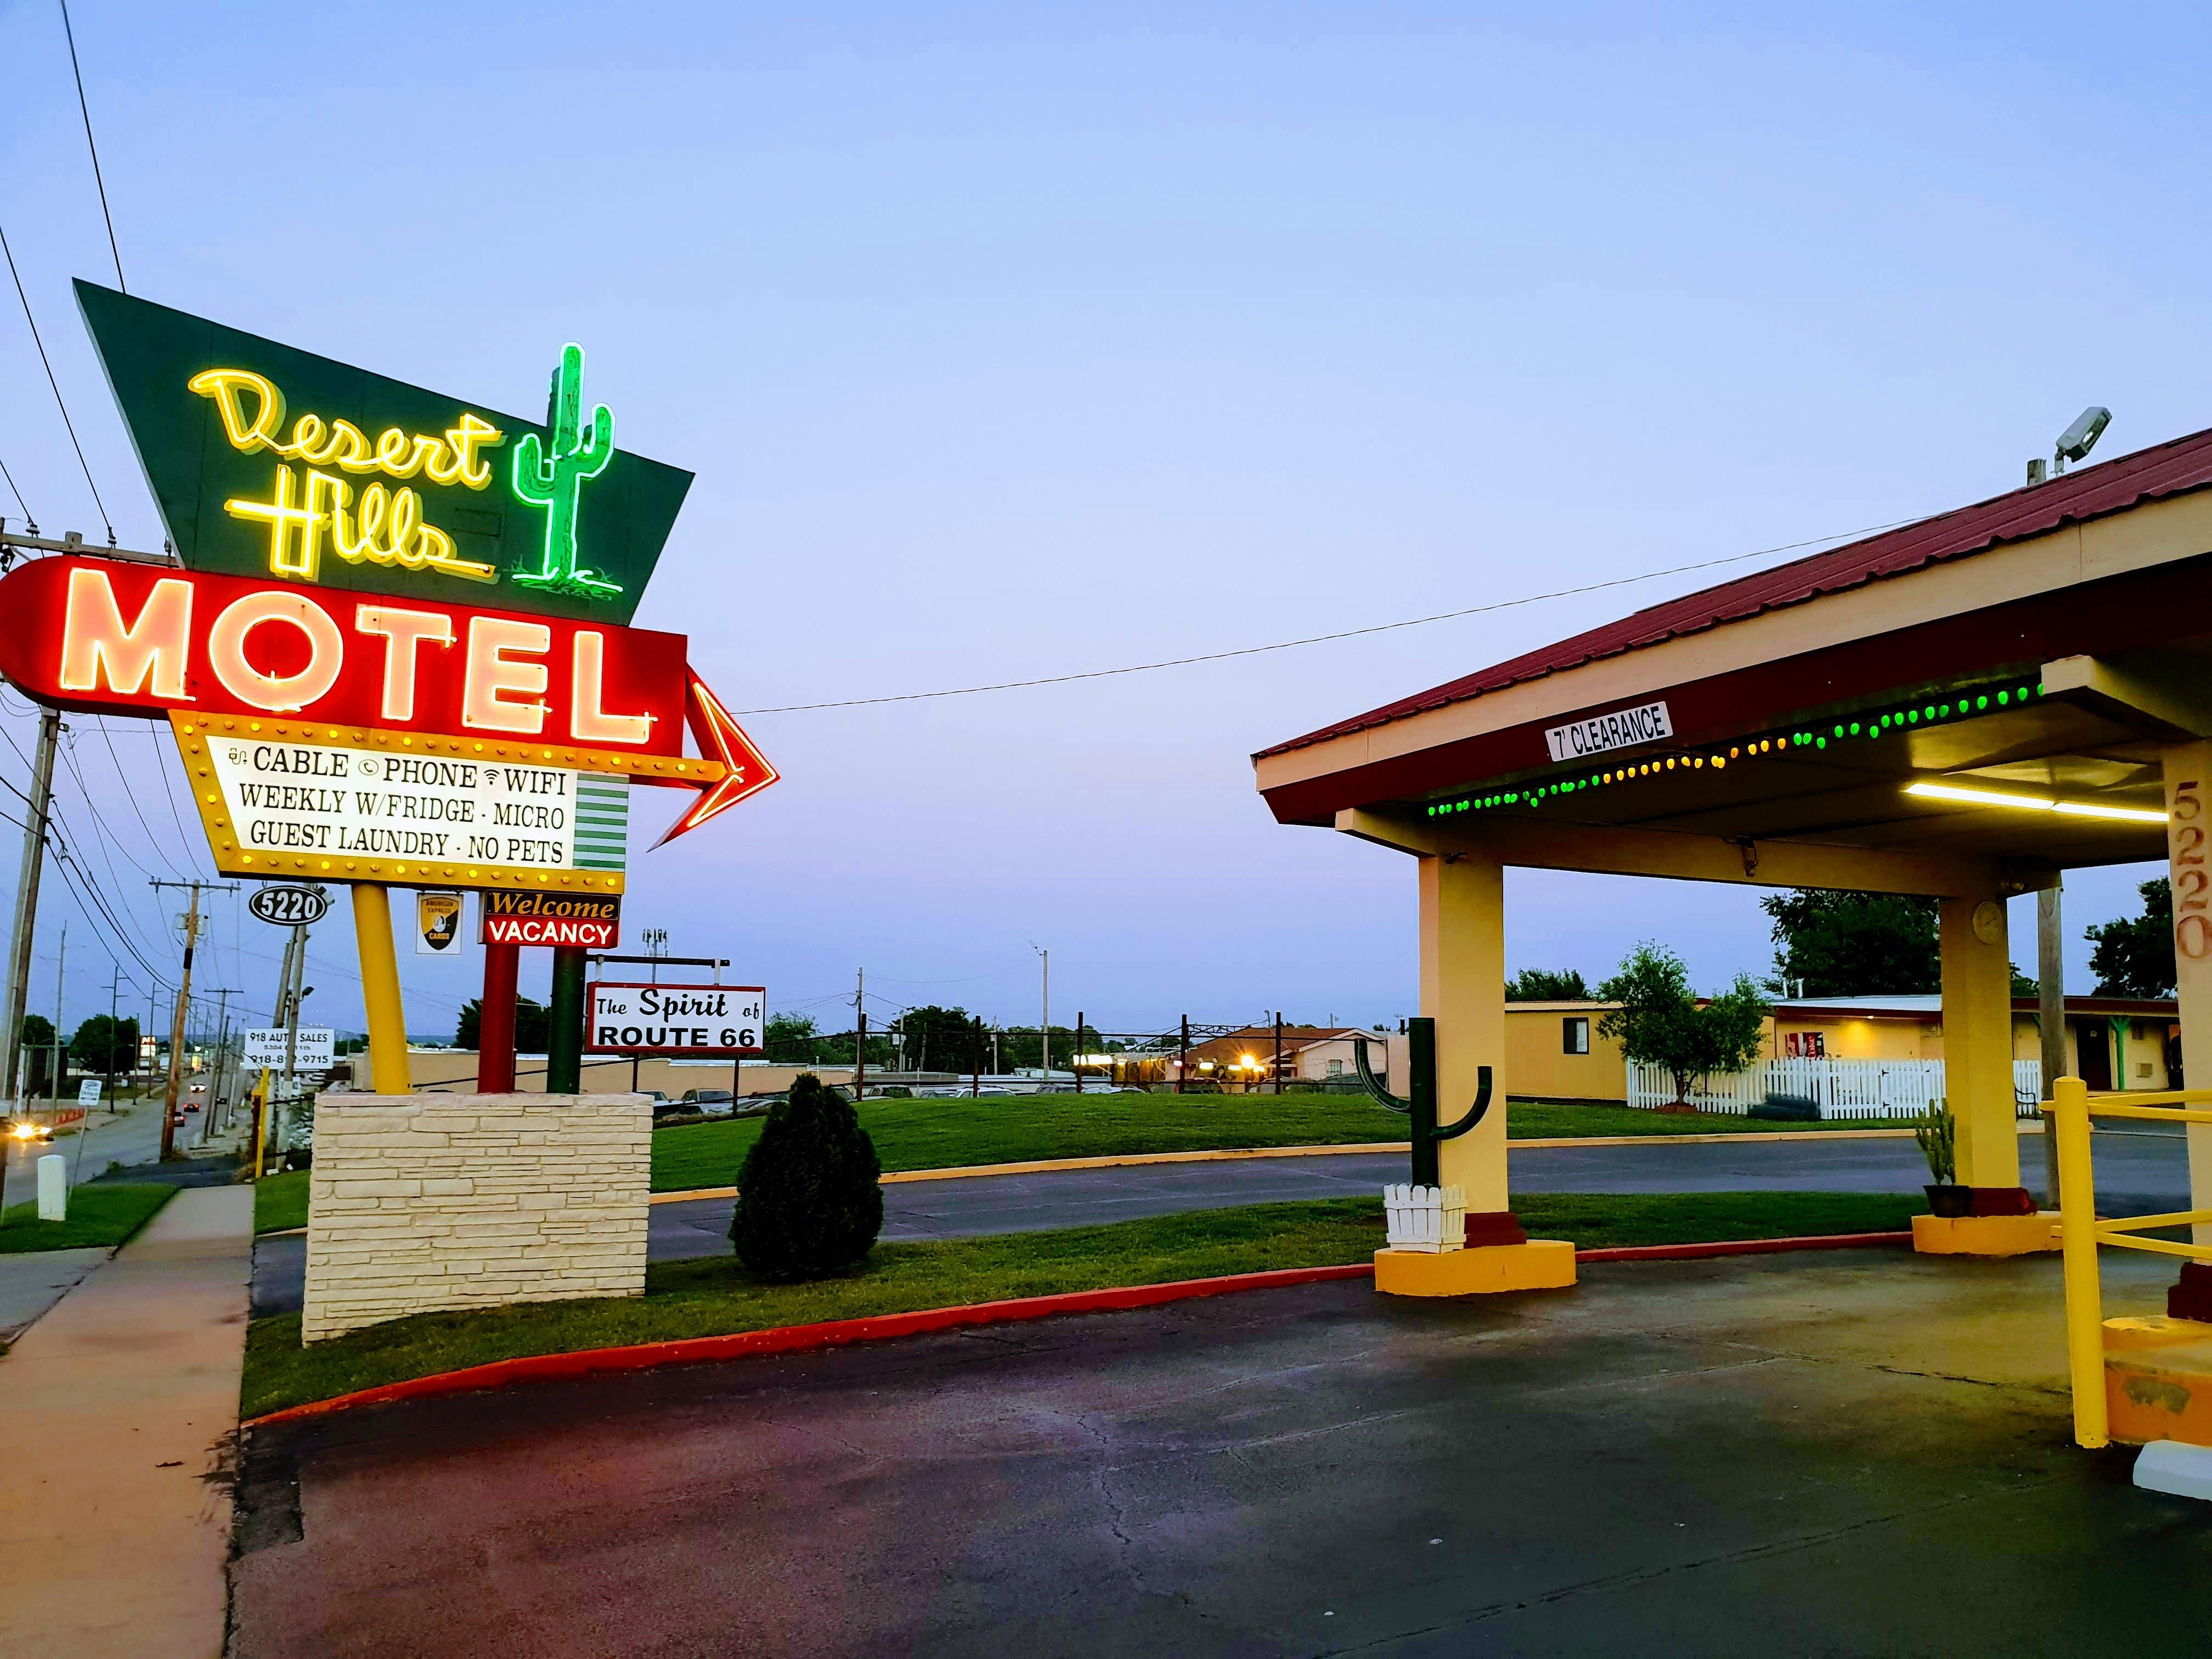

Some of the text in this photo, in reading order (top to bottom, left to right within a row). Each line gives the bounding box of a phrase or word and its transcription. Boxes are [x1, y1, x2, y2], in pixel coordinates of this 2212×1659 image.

[189, 369, 506, 488] Desert
[224, 464, 498, 582] Hills
[59, 567, 658, 744] MOTEL
[1554, 705, 1666, 758] 7' CLEARANCE
[253, 746, 566, 795] CABLE PHONE WIFI
[239, 783, 564, 830] WEEKLY W/FRIDGE MICRO
[251, 820, 563, 864] GUEST LAUNDRY NO PETS
[2174, 780, 2212, 959] 5220
[261, 891, 317, 919] 5220
[493, 892, 614, 918] Welcome
[489, 921, 612, 945] VACANCY
[597, 988, 760, 1023] The Spirit of
[250, 1032, 328, 1042] 918 AUT SALES
[599, 1026, 755, 1047] ROUTE 66
